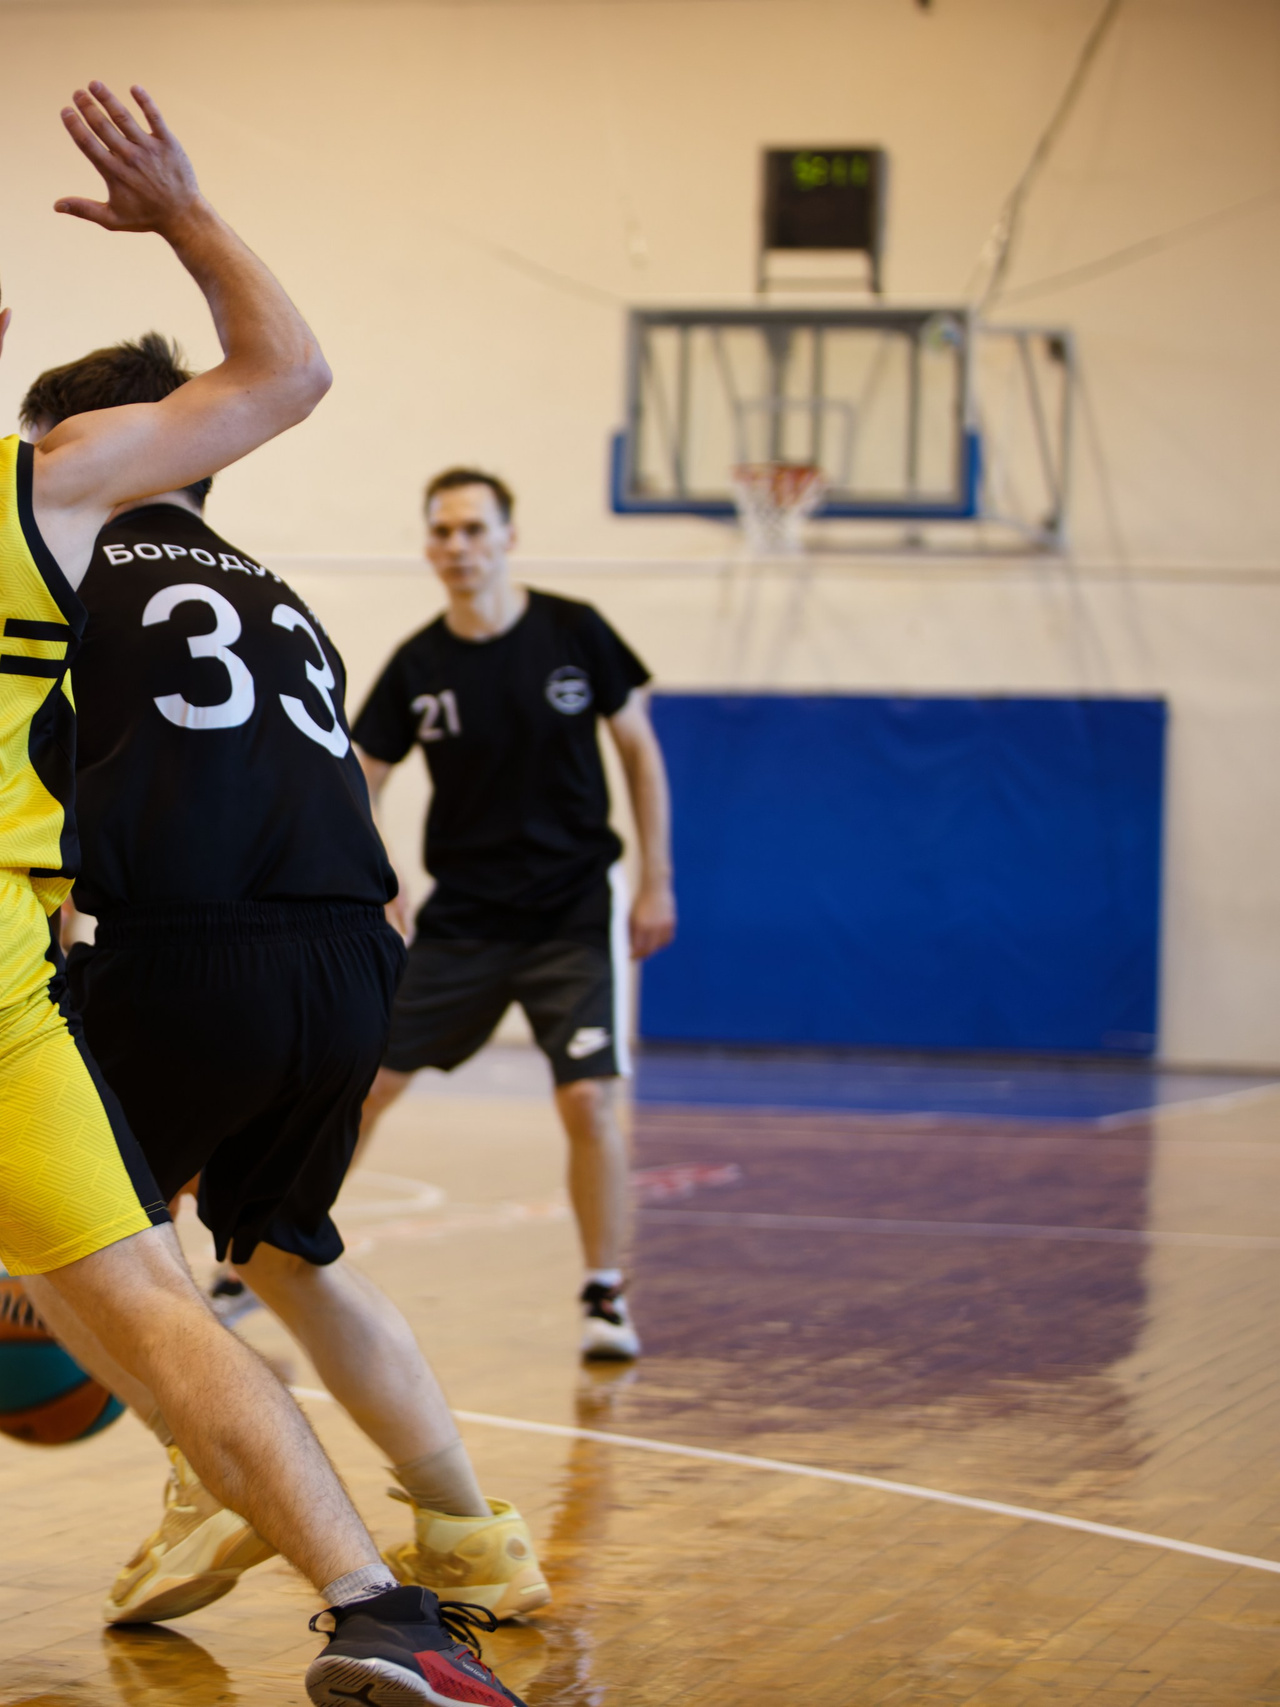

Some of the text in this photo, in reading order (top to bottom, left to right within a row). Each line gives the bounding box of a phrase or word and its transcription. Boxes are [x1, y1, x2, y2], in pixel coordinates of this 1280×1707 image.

[103, 543, 282, 583] БОРОДУ
[142, 583, 349, 759] 33
[410, 688, 462, 740] 21
